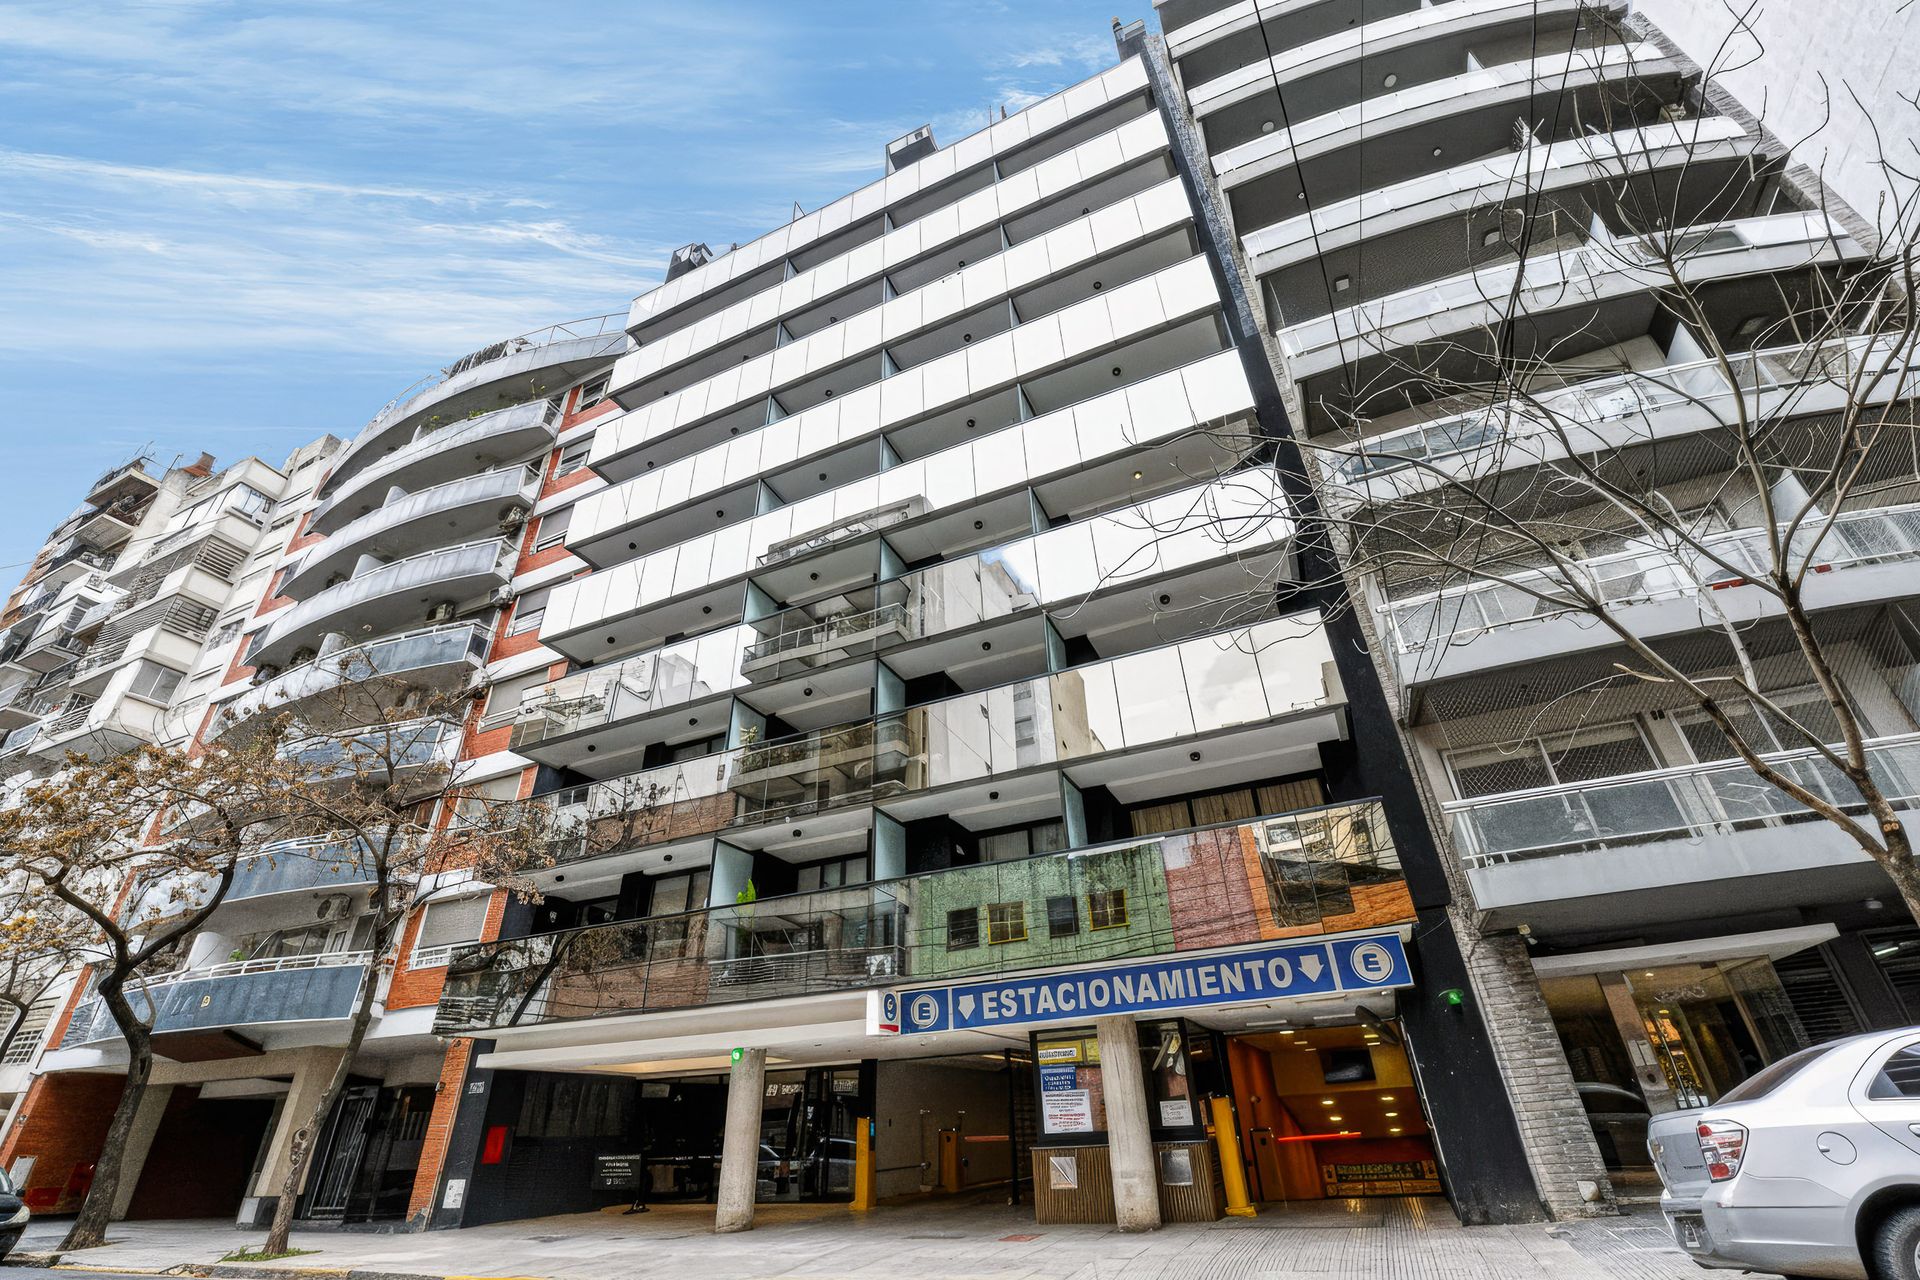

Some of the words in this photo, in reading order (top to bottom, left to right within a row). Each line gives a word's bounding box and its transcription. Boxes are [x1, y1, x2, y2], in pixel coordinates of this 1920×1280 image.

[1362, 953, 1382, 972] E
[982, 957, 1293, 1020] ESTACIONAMIENTO
[918, 1002, 931, 1021] E
